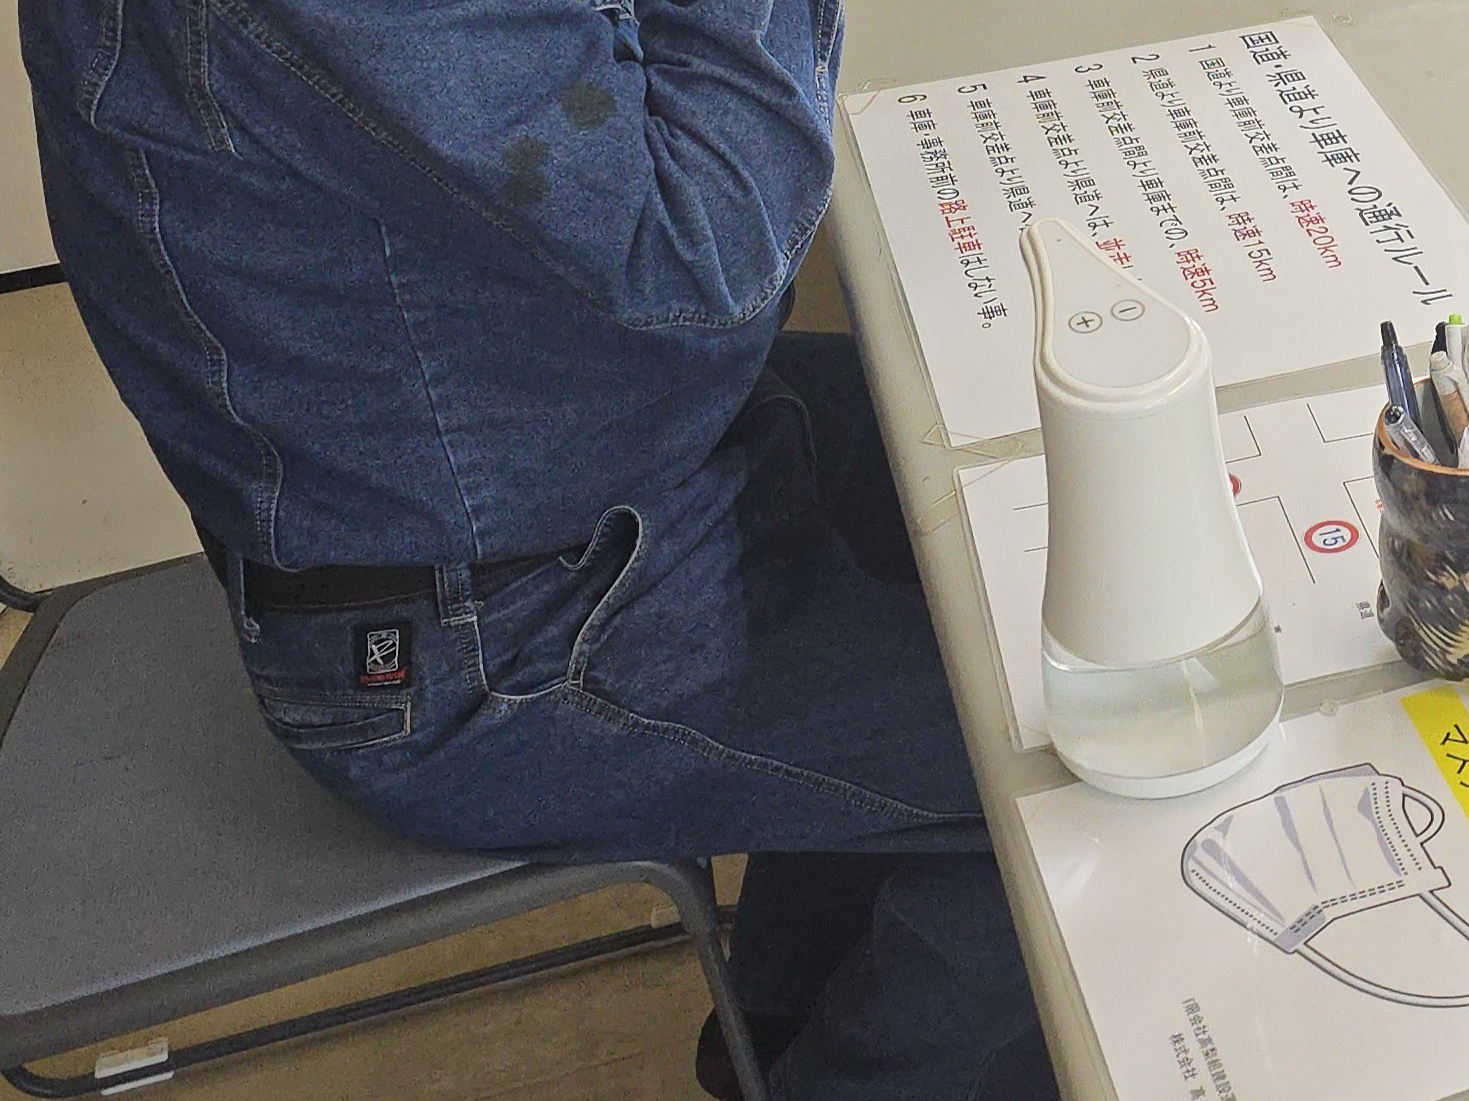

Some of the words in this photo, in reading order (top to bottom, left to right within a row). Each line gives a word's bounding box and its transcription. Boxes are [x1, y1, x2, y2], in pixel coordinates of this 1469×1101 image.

[1188, 43, 1217, 53] 1
[1131, 53, 1160, 65] 2
[1074, 63, 1104, 74] 3
[1016, 73, 1047, 84] 4
[957, 82, 988, 95] 5
[897, 93, 928, 104] 6
[1239, 30, 1453, 306] 国道・県道より車庫への通行ルール
[1318, 528, 1346, 547] 15
